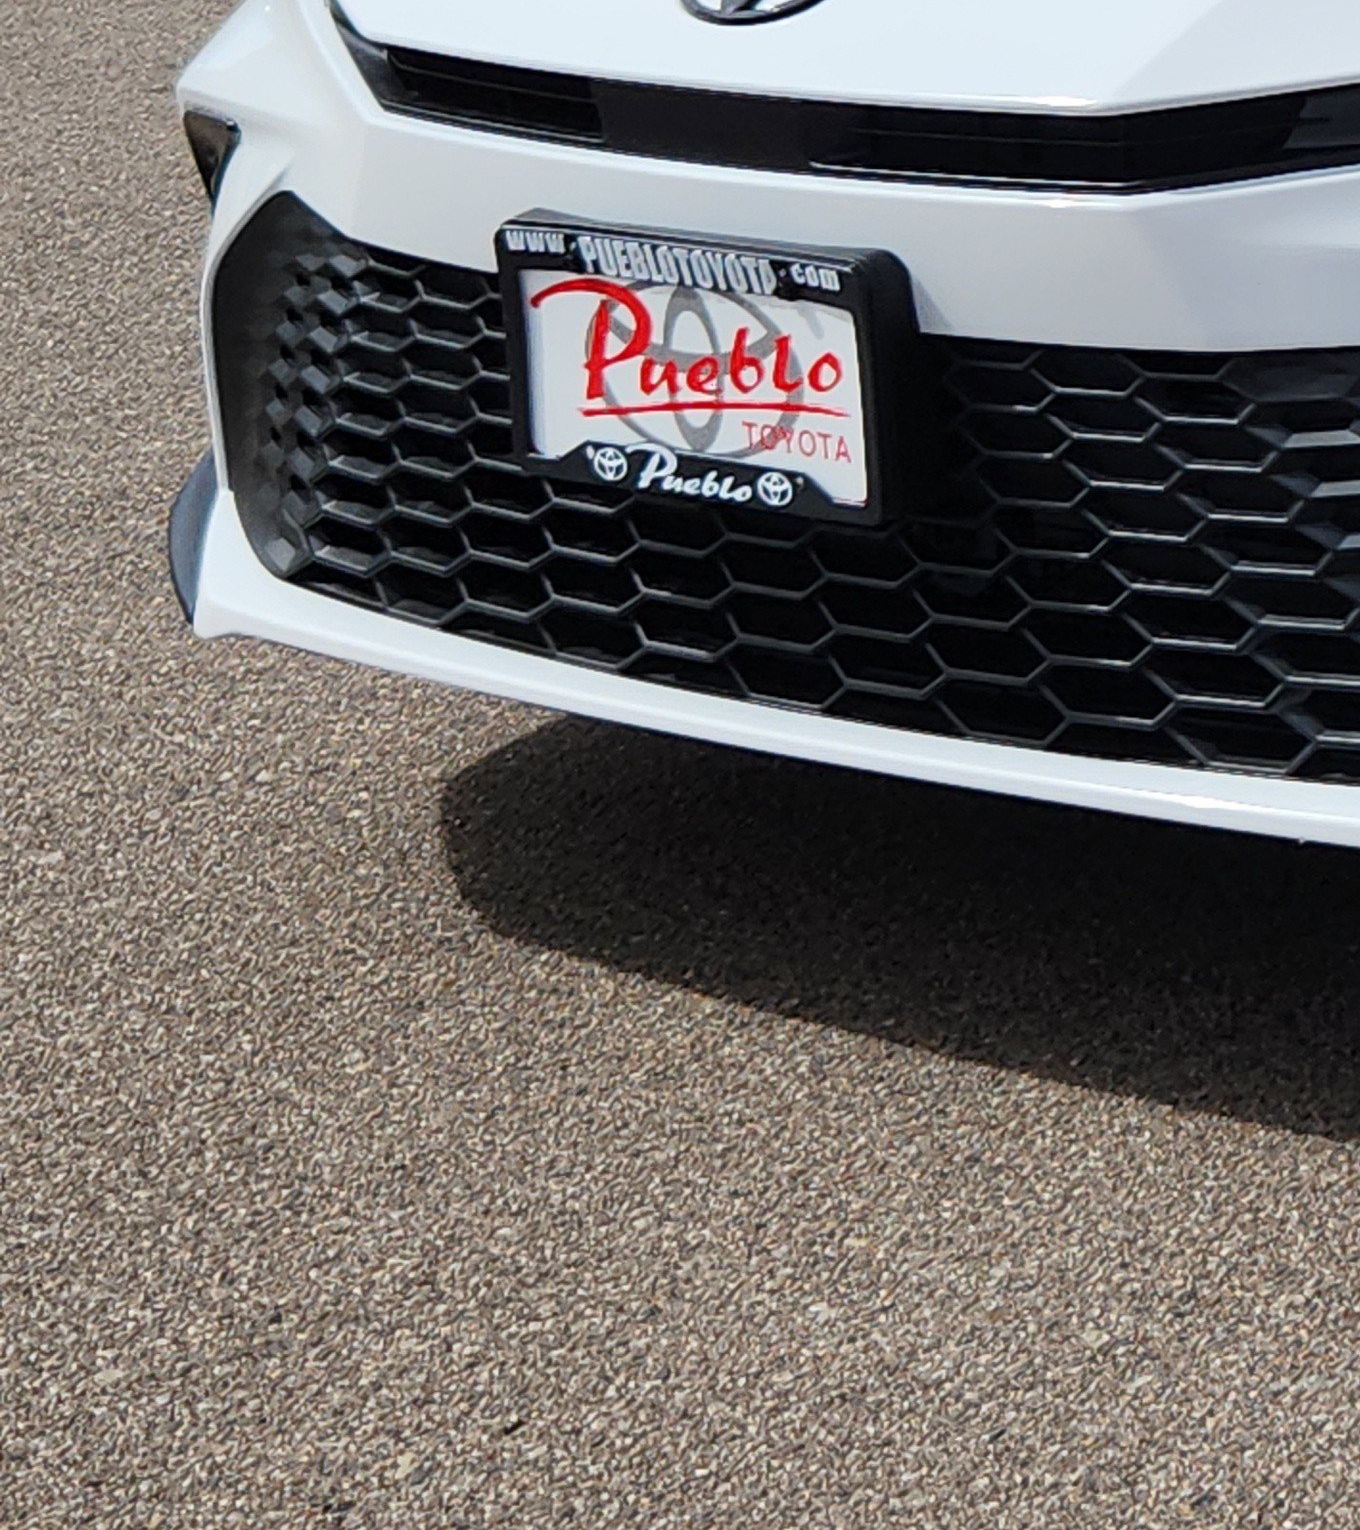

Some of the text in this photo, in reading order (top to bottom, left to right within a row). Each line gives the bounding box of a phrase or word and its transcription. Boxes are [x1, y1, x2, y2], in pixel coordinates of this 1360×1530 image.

[530, 277, 843, 400] Pueblo
[742, 421, 852, 463] TOYOTA
[626, 443, 753, 502] Pueblo
